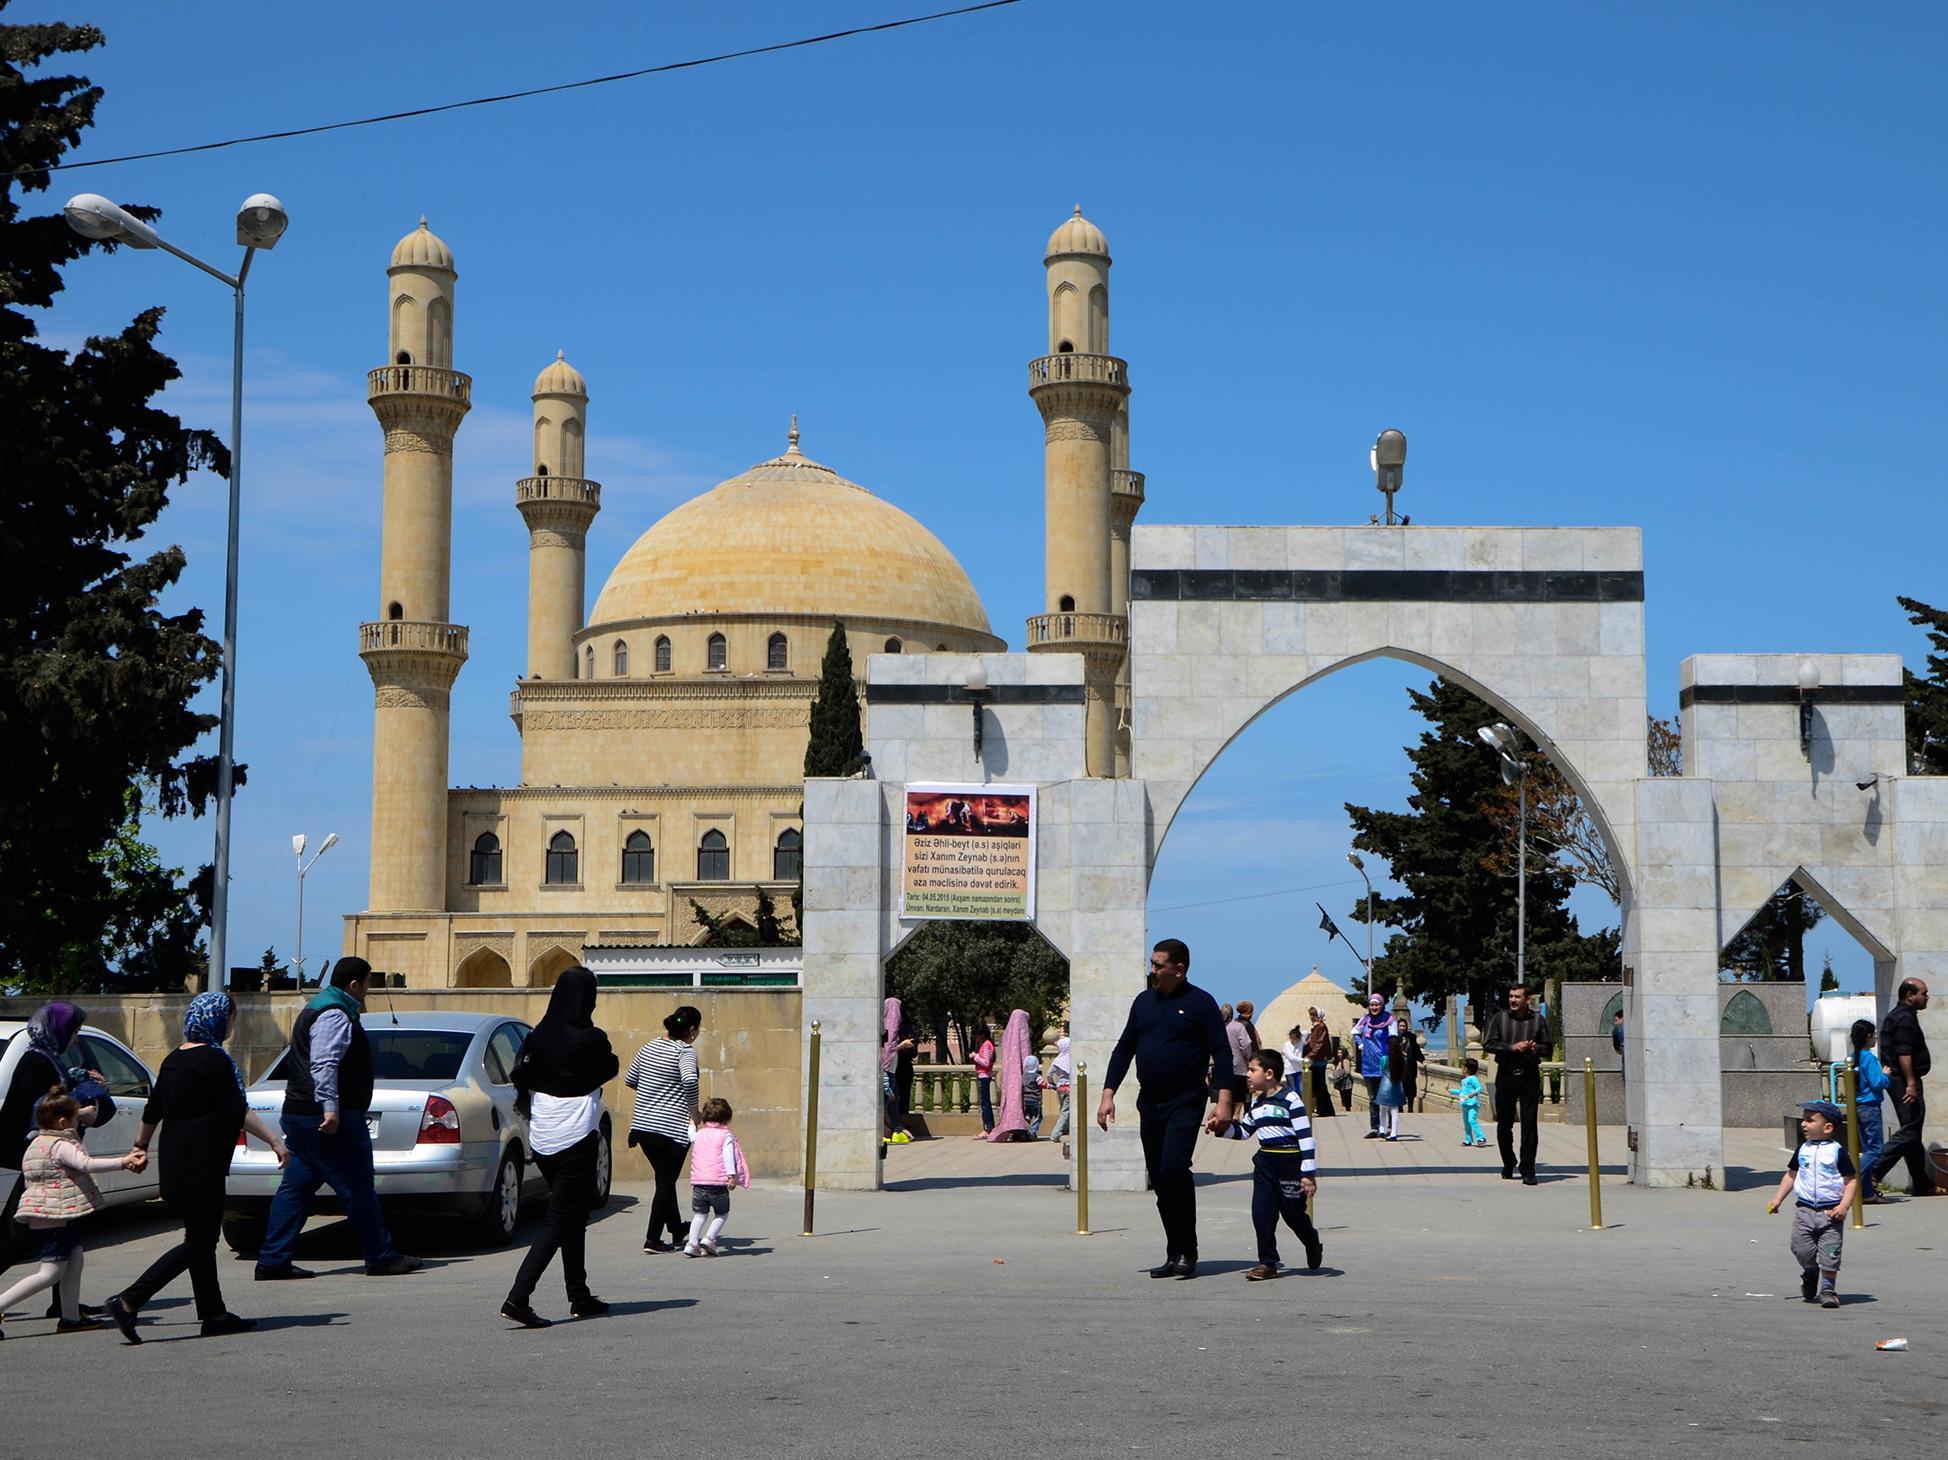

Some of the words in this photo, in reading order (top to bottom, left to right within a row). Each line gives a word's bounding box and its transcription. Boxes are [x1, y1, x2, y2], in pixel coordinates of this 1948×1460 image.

[915, 838, 931, 848] Əziz
[934, 838, 969, 849] Əhli-beyt
[972, 840, 989, 850] (ə.s)
[930, 853, 956, 861] Xanım
[958, 853, 988, 863] Zeynəb
[932, 866, 983, 875] münasibətilə
[986, 868, 1026, 878] qurulacaq
[930, 879, 968, 887] məclisinə
[970, 879, 992, 888] dəvət
[995, 880, 1019, 889] edirik.
[922, 893, 949, 901] 04.05.2015
[1004, 896, 1020, 904] sonra)
